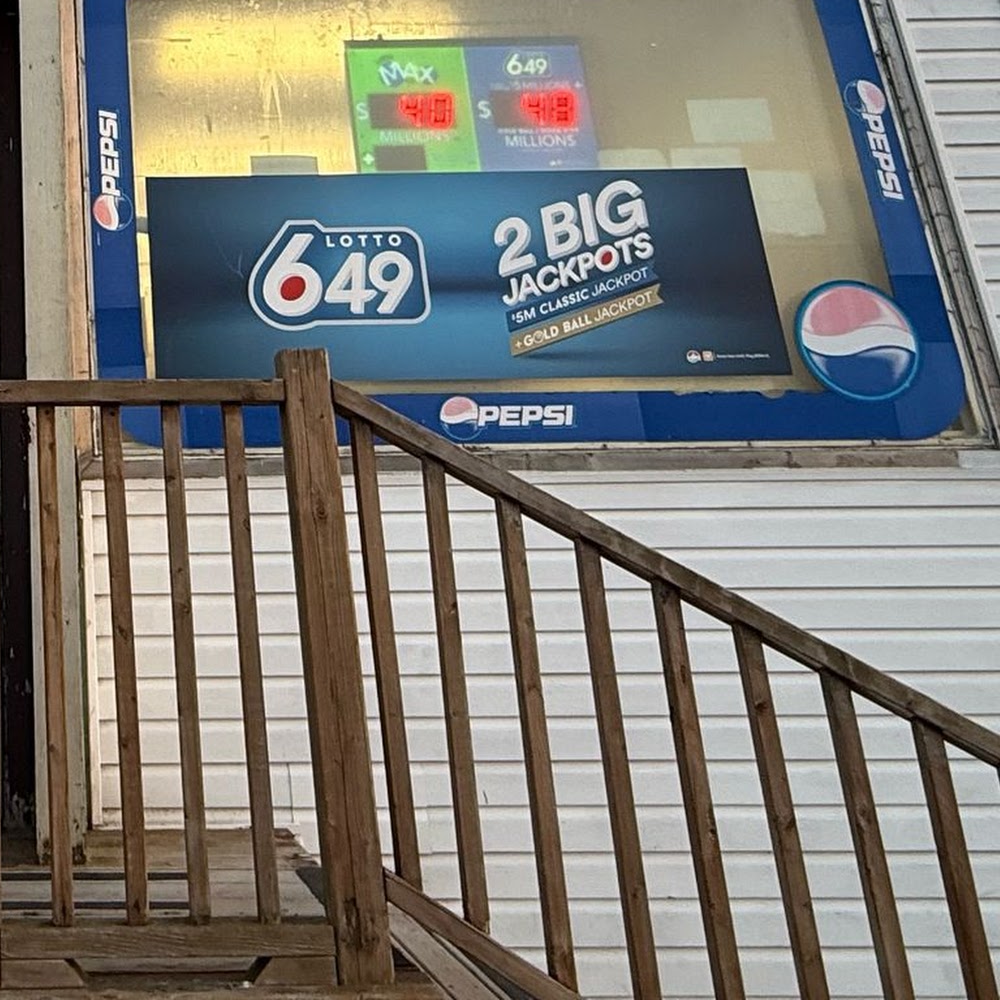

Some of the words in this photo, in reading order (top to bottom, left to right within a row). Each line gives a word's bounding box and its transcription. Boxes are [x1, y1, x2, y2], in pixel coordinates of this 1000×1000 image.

[506, 53, 547, 76] 649
[399, 93, 453, 129] 40
[521, 91, 576, 128] 48
[98, 109, 120, 197] PEPSI
[505, 134, 577, 147] MILLIONS
[861, 112, 904, 200] PEPSI
[326, 234, 402, 247] LOTTO
[494, 217, 537, 277] 2
[540, 180, 650, 260] BIG
[263, 233, 414, 317] 649
[502, 232, 654, 307] JACKPOTS
[539, 289, 590, 315] CLASSIC
[591, 267, 649, 297] JACKPOT
[523, 326, 559, 346] GOLD
[563, 314, 592, 333] BALL
[594, 291, 653, 323] JACKPOT
[478, 405, 573, 426] PEPSI
